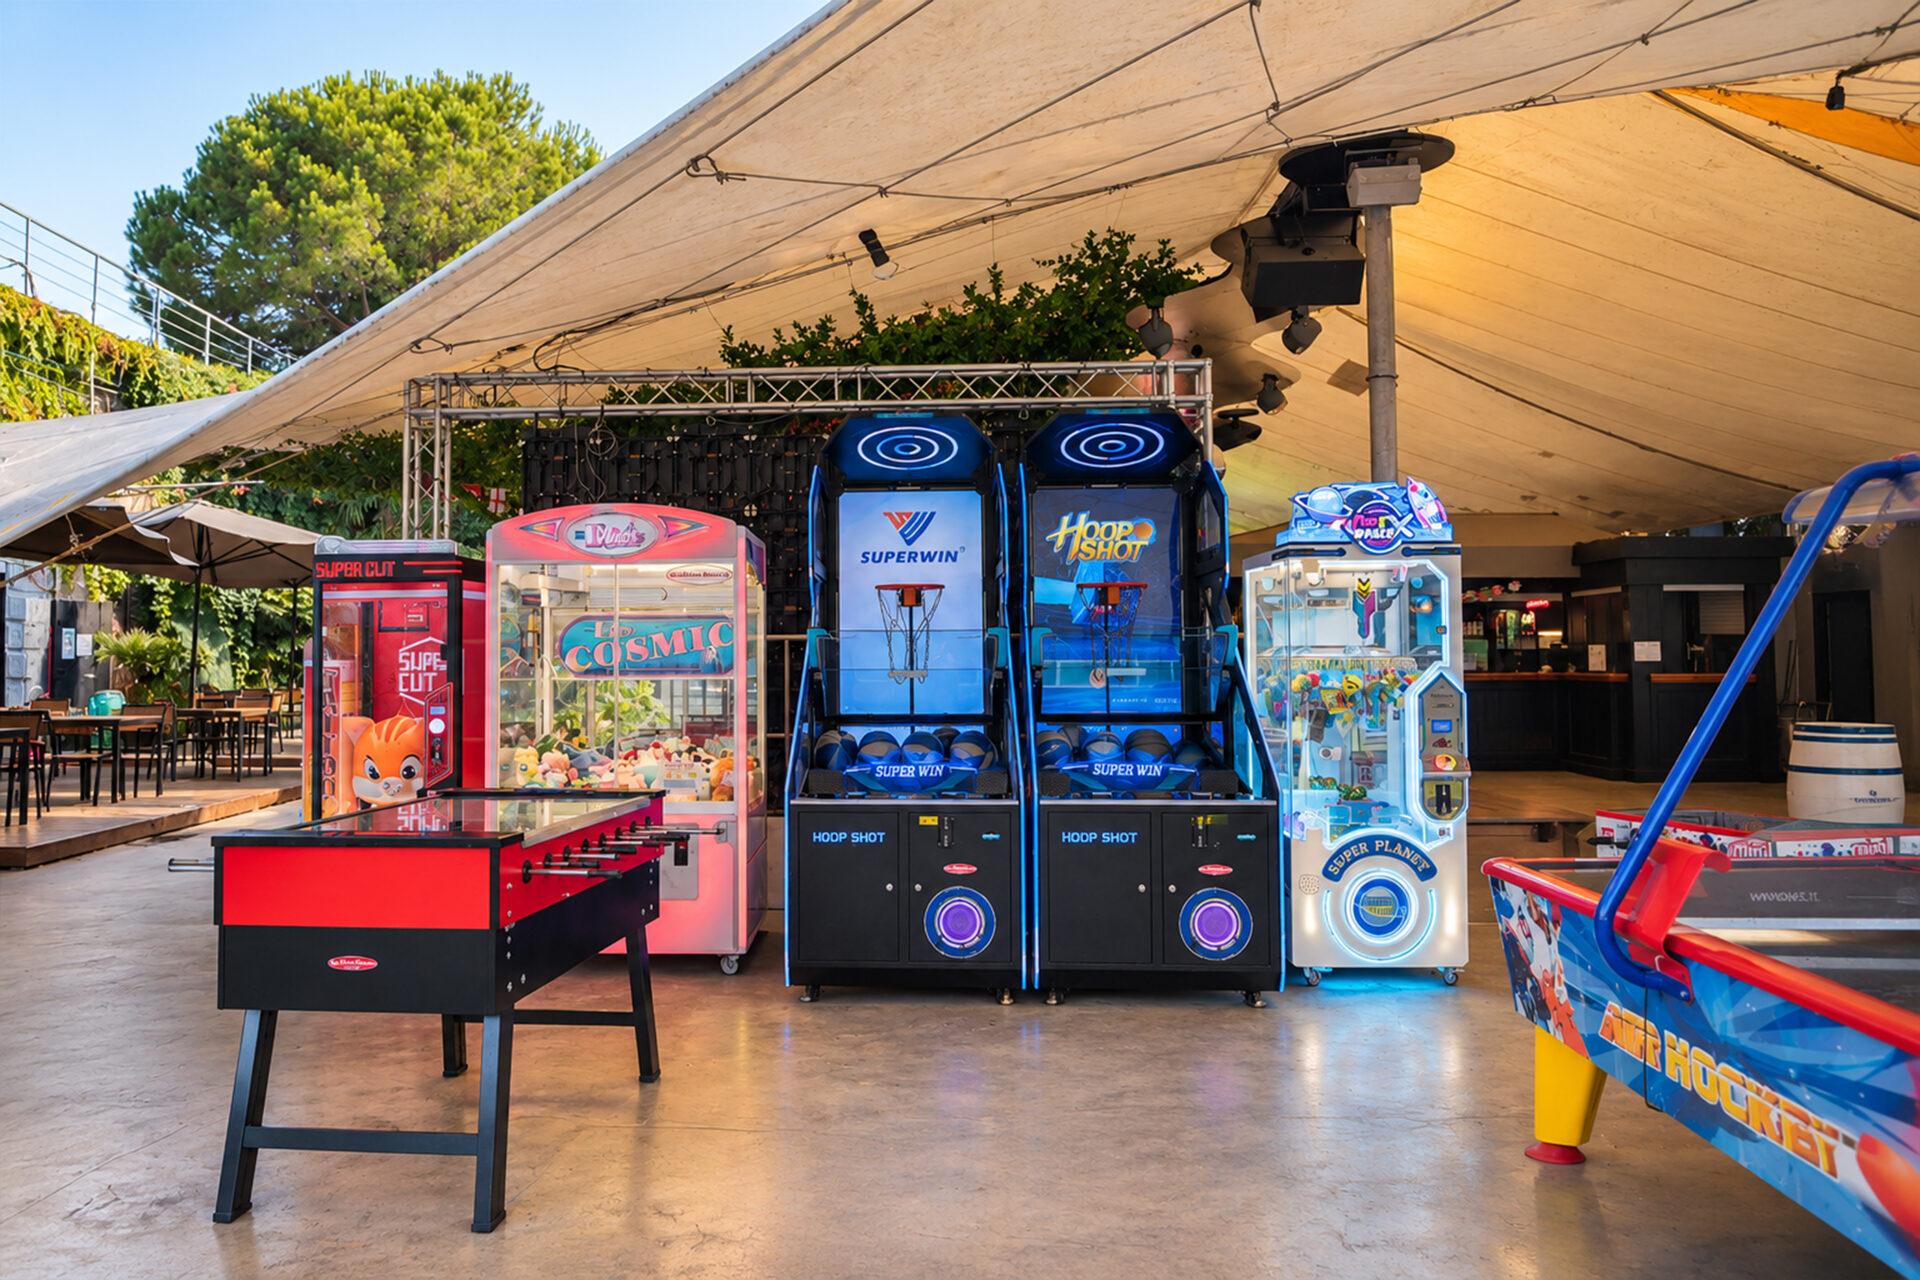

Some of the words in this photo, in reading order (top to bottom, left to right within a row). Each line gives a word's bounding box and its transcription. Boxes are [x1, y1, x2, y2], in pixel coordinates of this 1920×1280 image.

[1045, 511, 1135, 565] HOOP
[860, 550, 959, 564] SUPERWIN
[1078, 539, 1149, 562] SHOT
[315, 561, 362, 578] SUPER
[365, 560, 396, 577] CUT
[564, 620, 734, 673] COSMIC
[399, 672, 438, 692] CUT
[875, 764, 916, 778] SUPER
[918, 764, 945, 778] WIN
[1092, 763, 1134, 777] SUPER
[1136, 763, 1163, 777] WIN
[812, 831, 848, 844] HOOP
[851, 831, 886, 844] SHOT
[1061, 831, 1098, 844] HOOP
[1102, 831, 1138, 844] SHOT
[1328, 841, 1369, 875] SUPER
